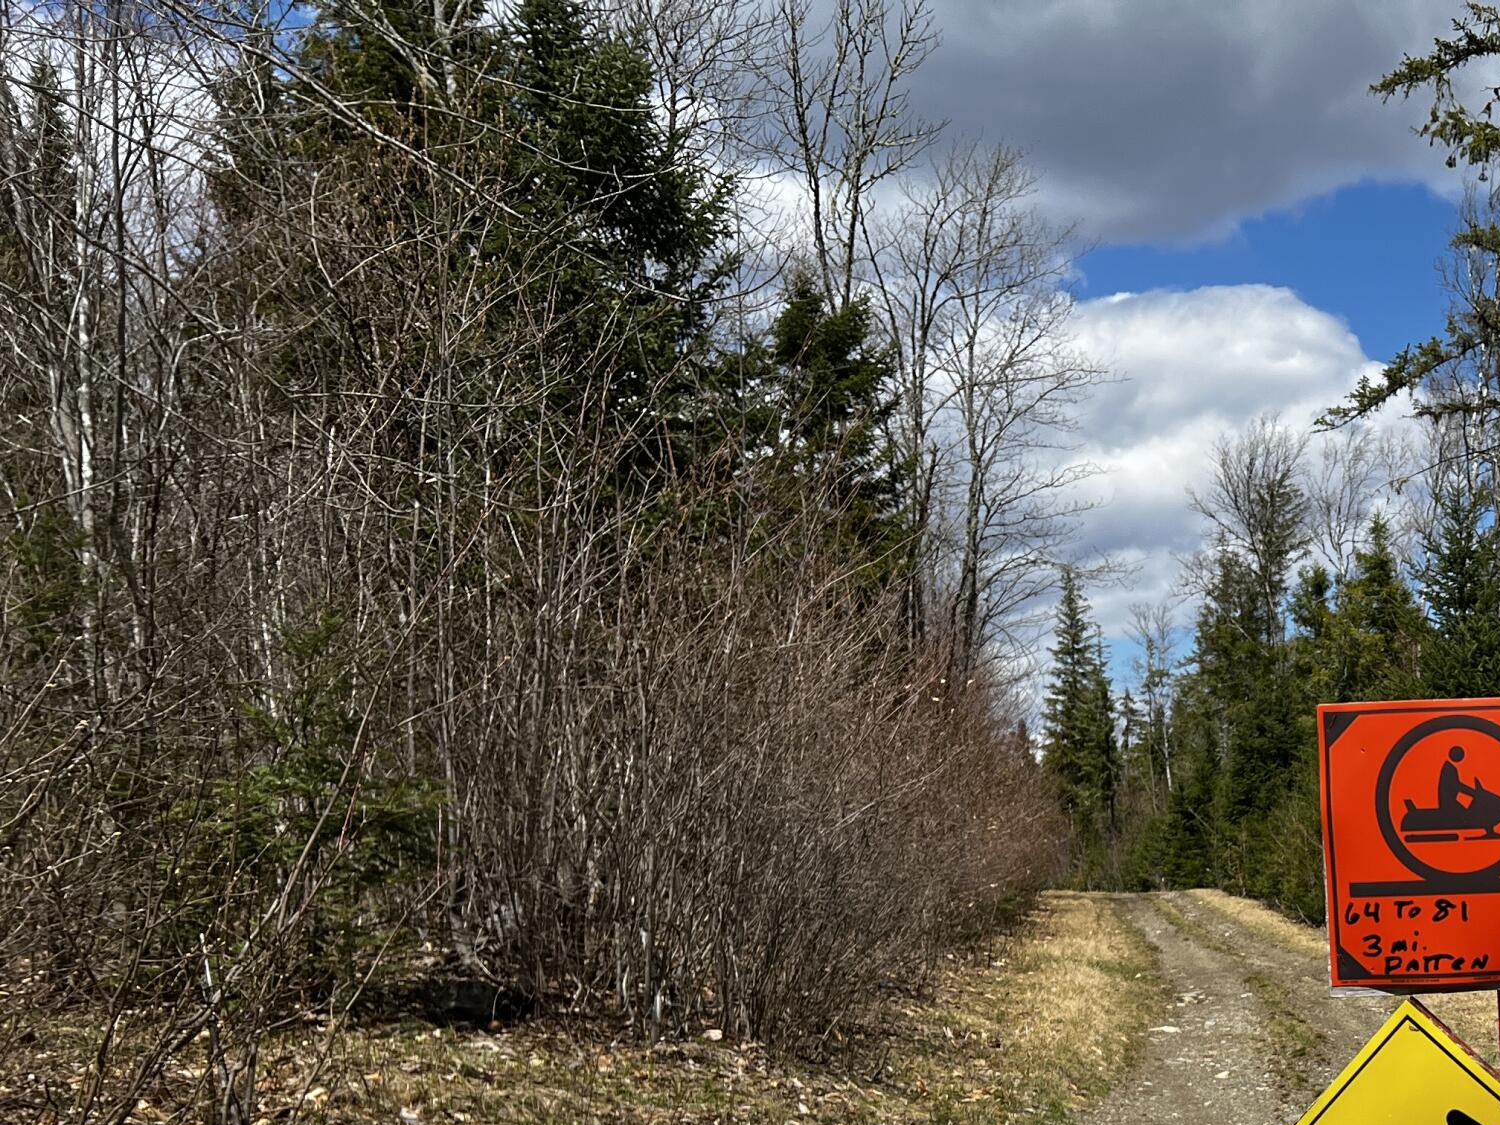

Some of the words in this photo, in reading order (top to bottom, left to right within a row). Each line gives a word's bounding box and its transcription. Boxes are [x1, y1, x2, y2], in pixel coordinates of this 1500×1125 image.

[1345, 902, 1380, 925] 64
[1432, 899, 1468, 922] 81
[1362, 934, 1382, 957] 3
